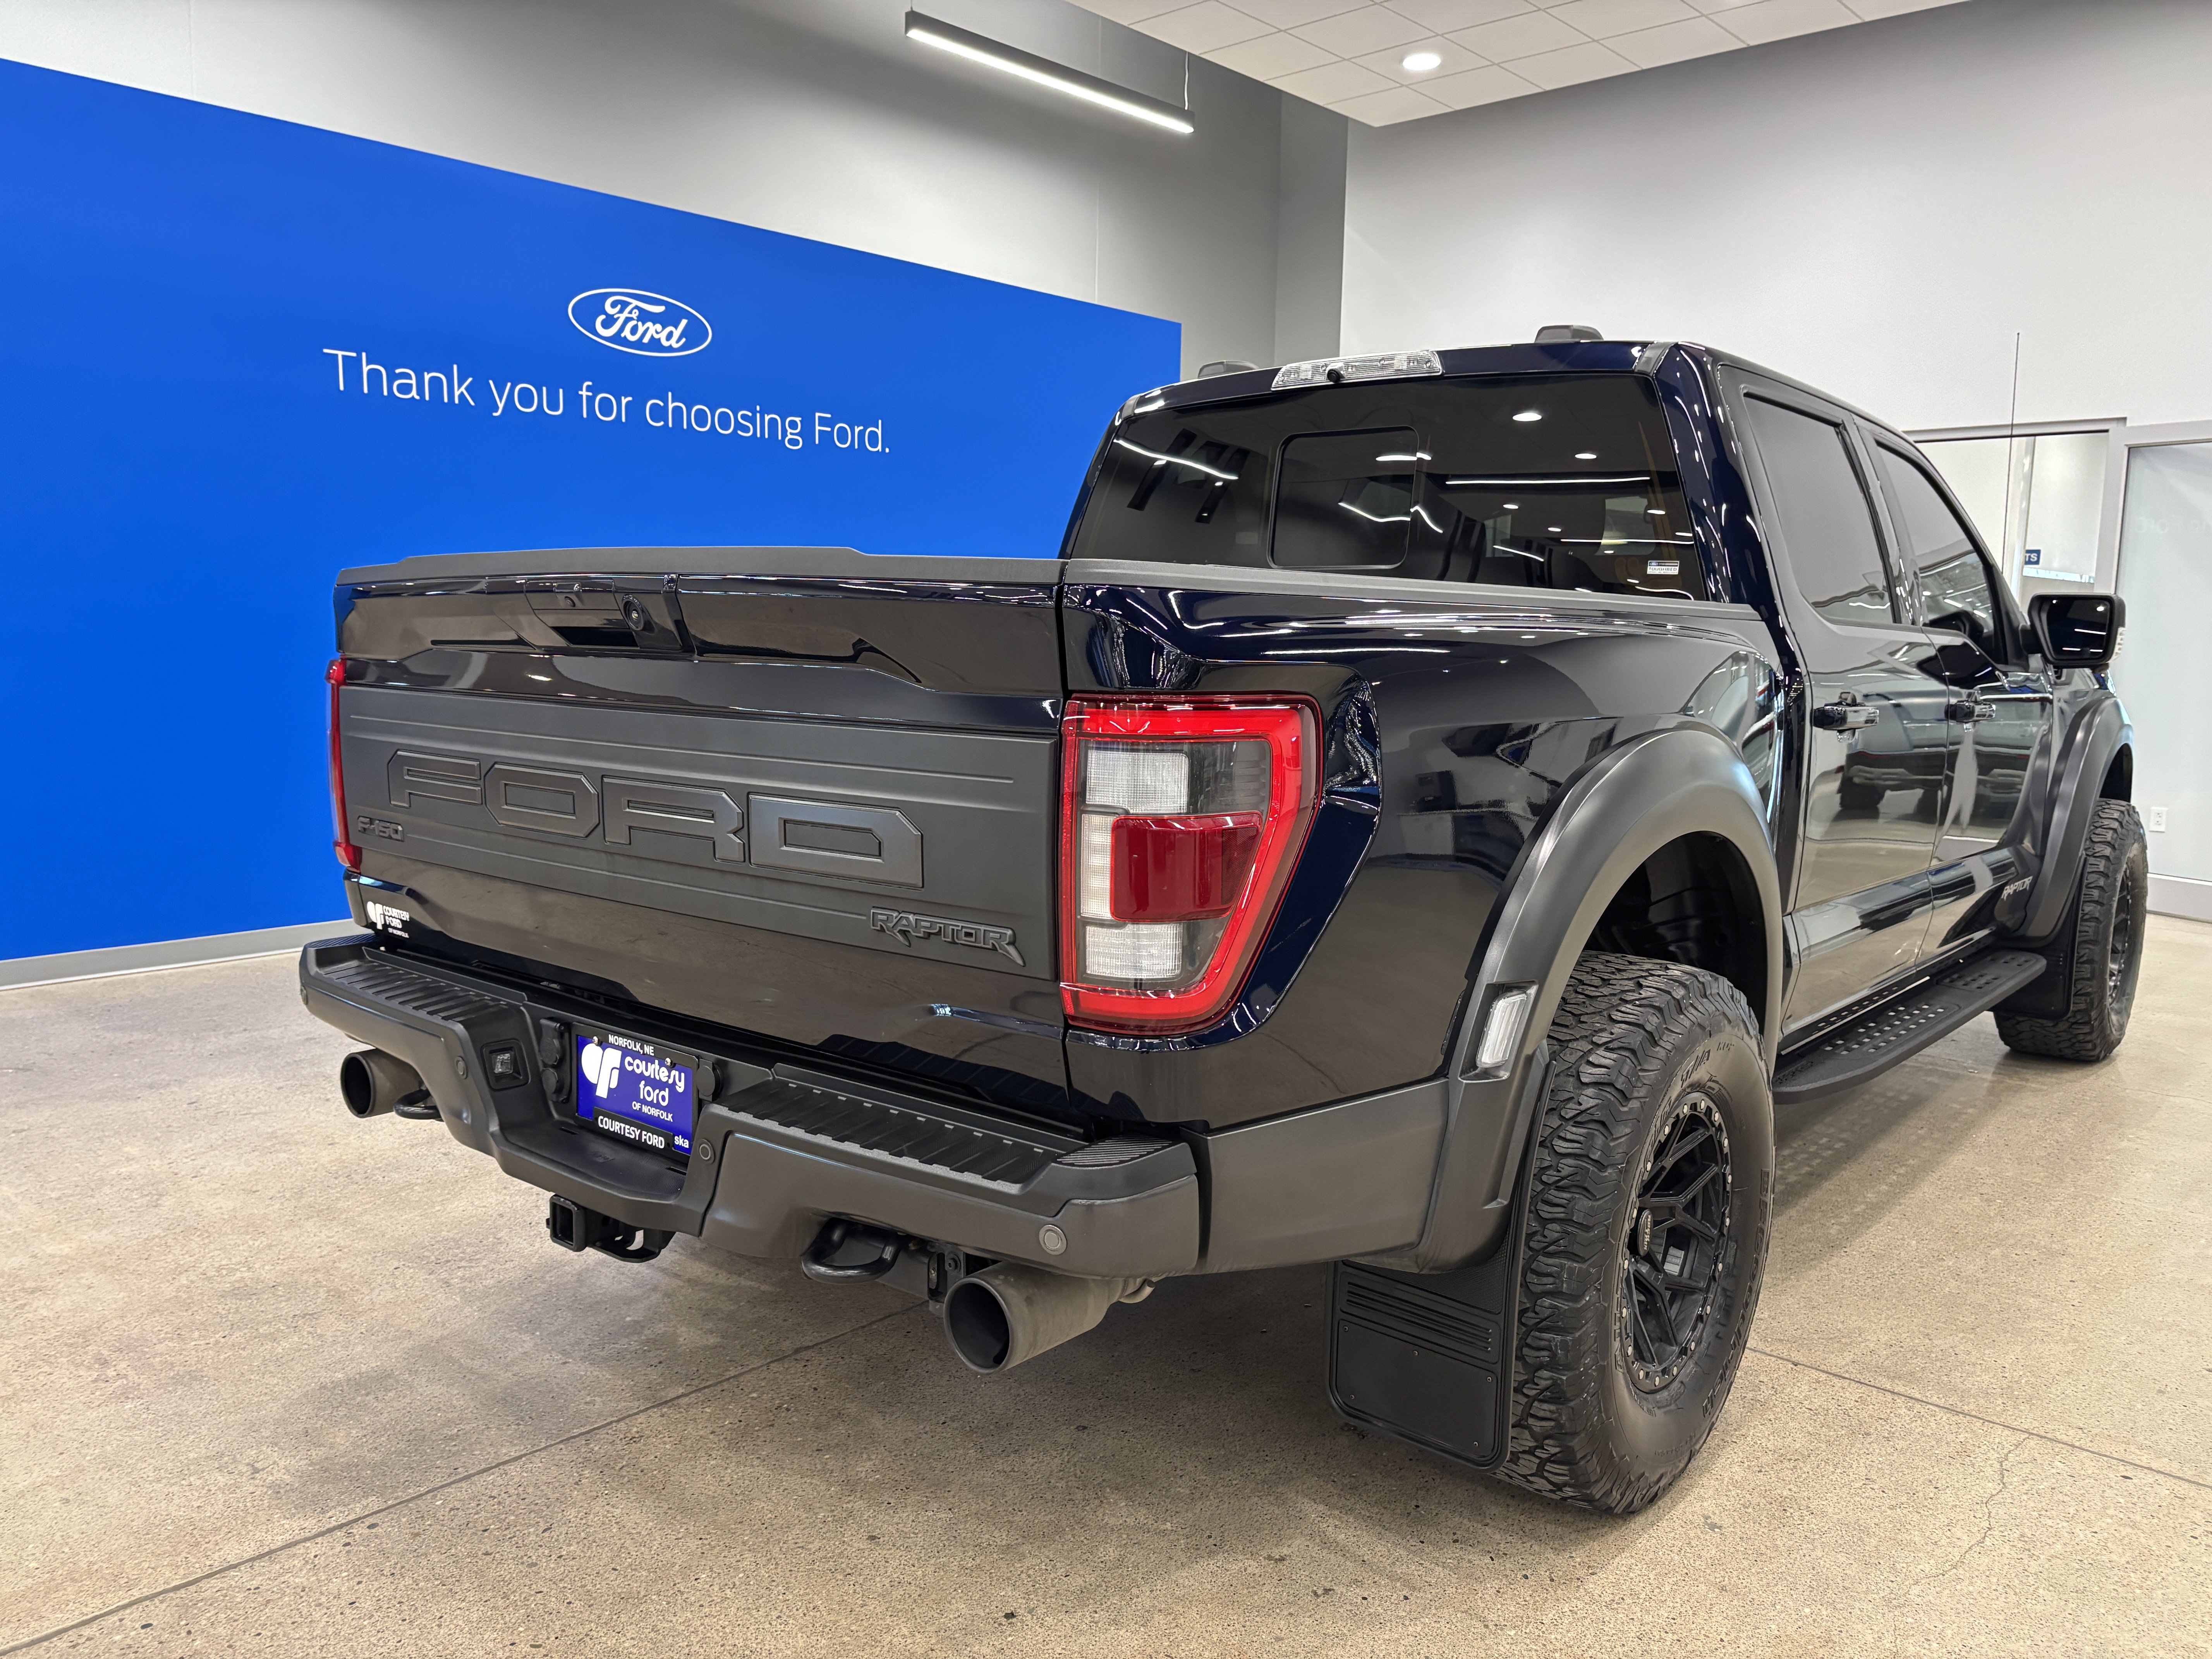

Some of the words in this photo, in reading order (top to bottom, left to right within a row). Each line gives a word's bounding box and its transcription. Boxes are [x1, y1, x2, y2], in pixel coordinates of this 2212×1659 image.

[595, 295, 689, 349] Ford
[323, 349, 475, 406] Thank
[488, 380, 563, 416] you
[578, 381, 633, 422] for
[646, 392, 803, 450] choosing
[815, 412, 890, 453] Ford.
[357, 815, 405, 842] F-150
[387, 748, 923, 889] FORD
[2001, 876, 2033, 901] RAPTOR
[383, 905, 410, 921] COURTESY
[385, 916, 402, 929] FORD
[870, 906, 1027, 967] RAPTOR
[608, 1034, 643, 1054] NORFOLK,
[644, 1044, 654, 1056] NE
[624, 1056, 685, 1093] courtesy
[639, 1080, 669, 1106] ford
[632, 1101, 642, 1111] OF
[642, 1104, 673, 1122] NORFOLK
[598, 1115, 640, 1140] COURTESY
[642, 1130, 665, 1149] FORD
[674, 1135, 689, 1148] ska
